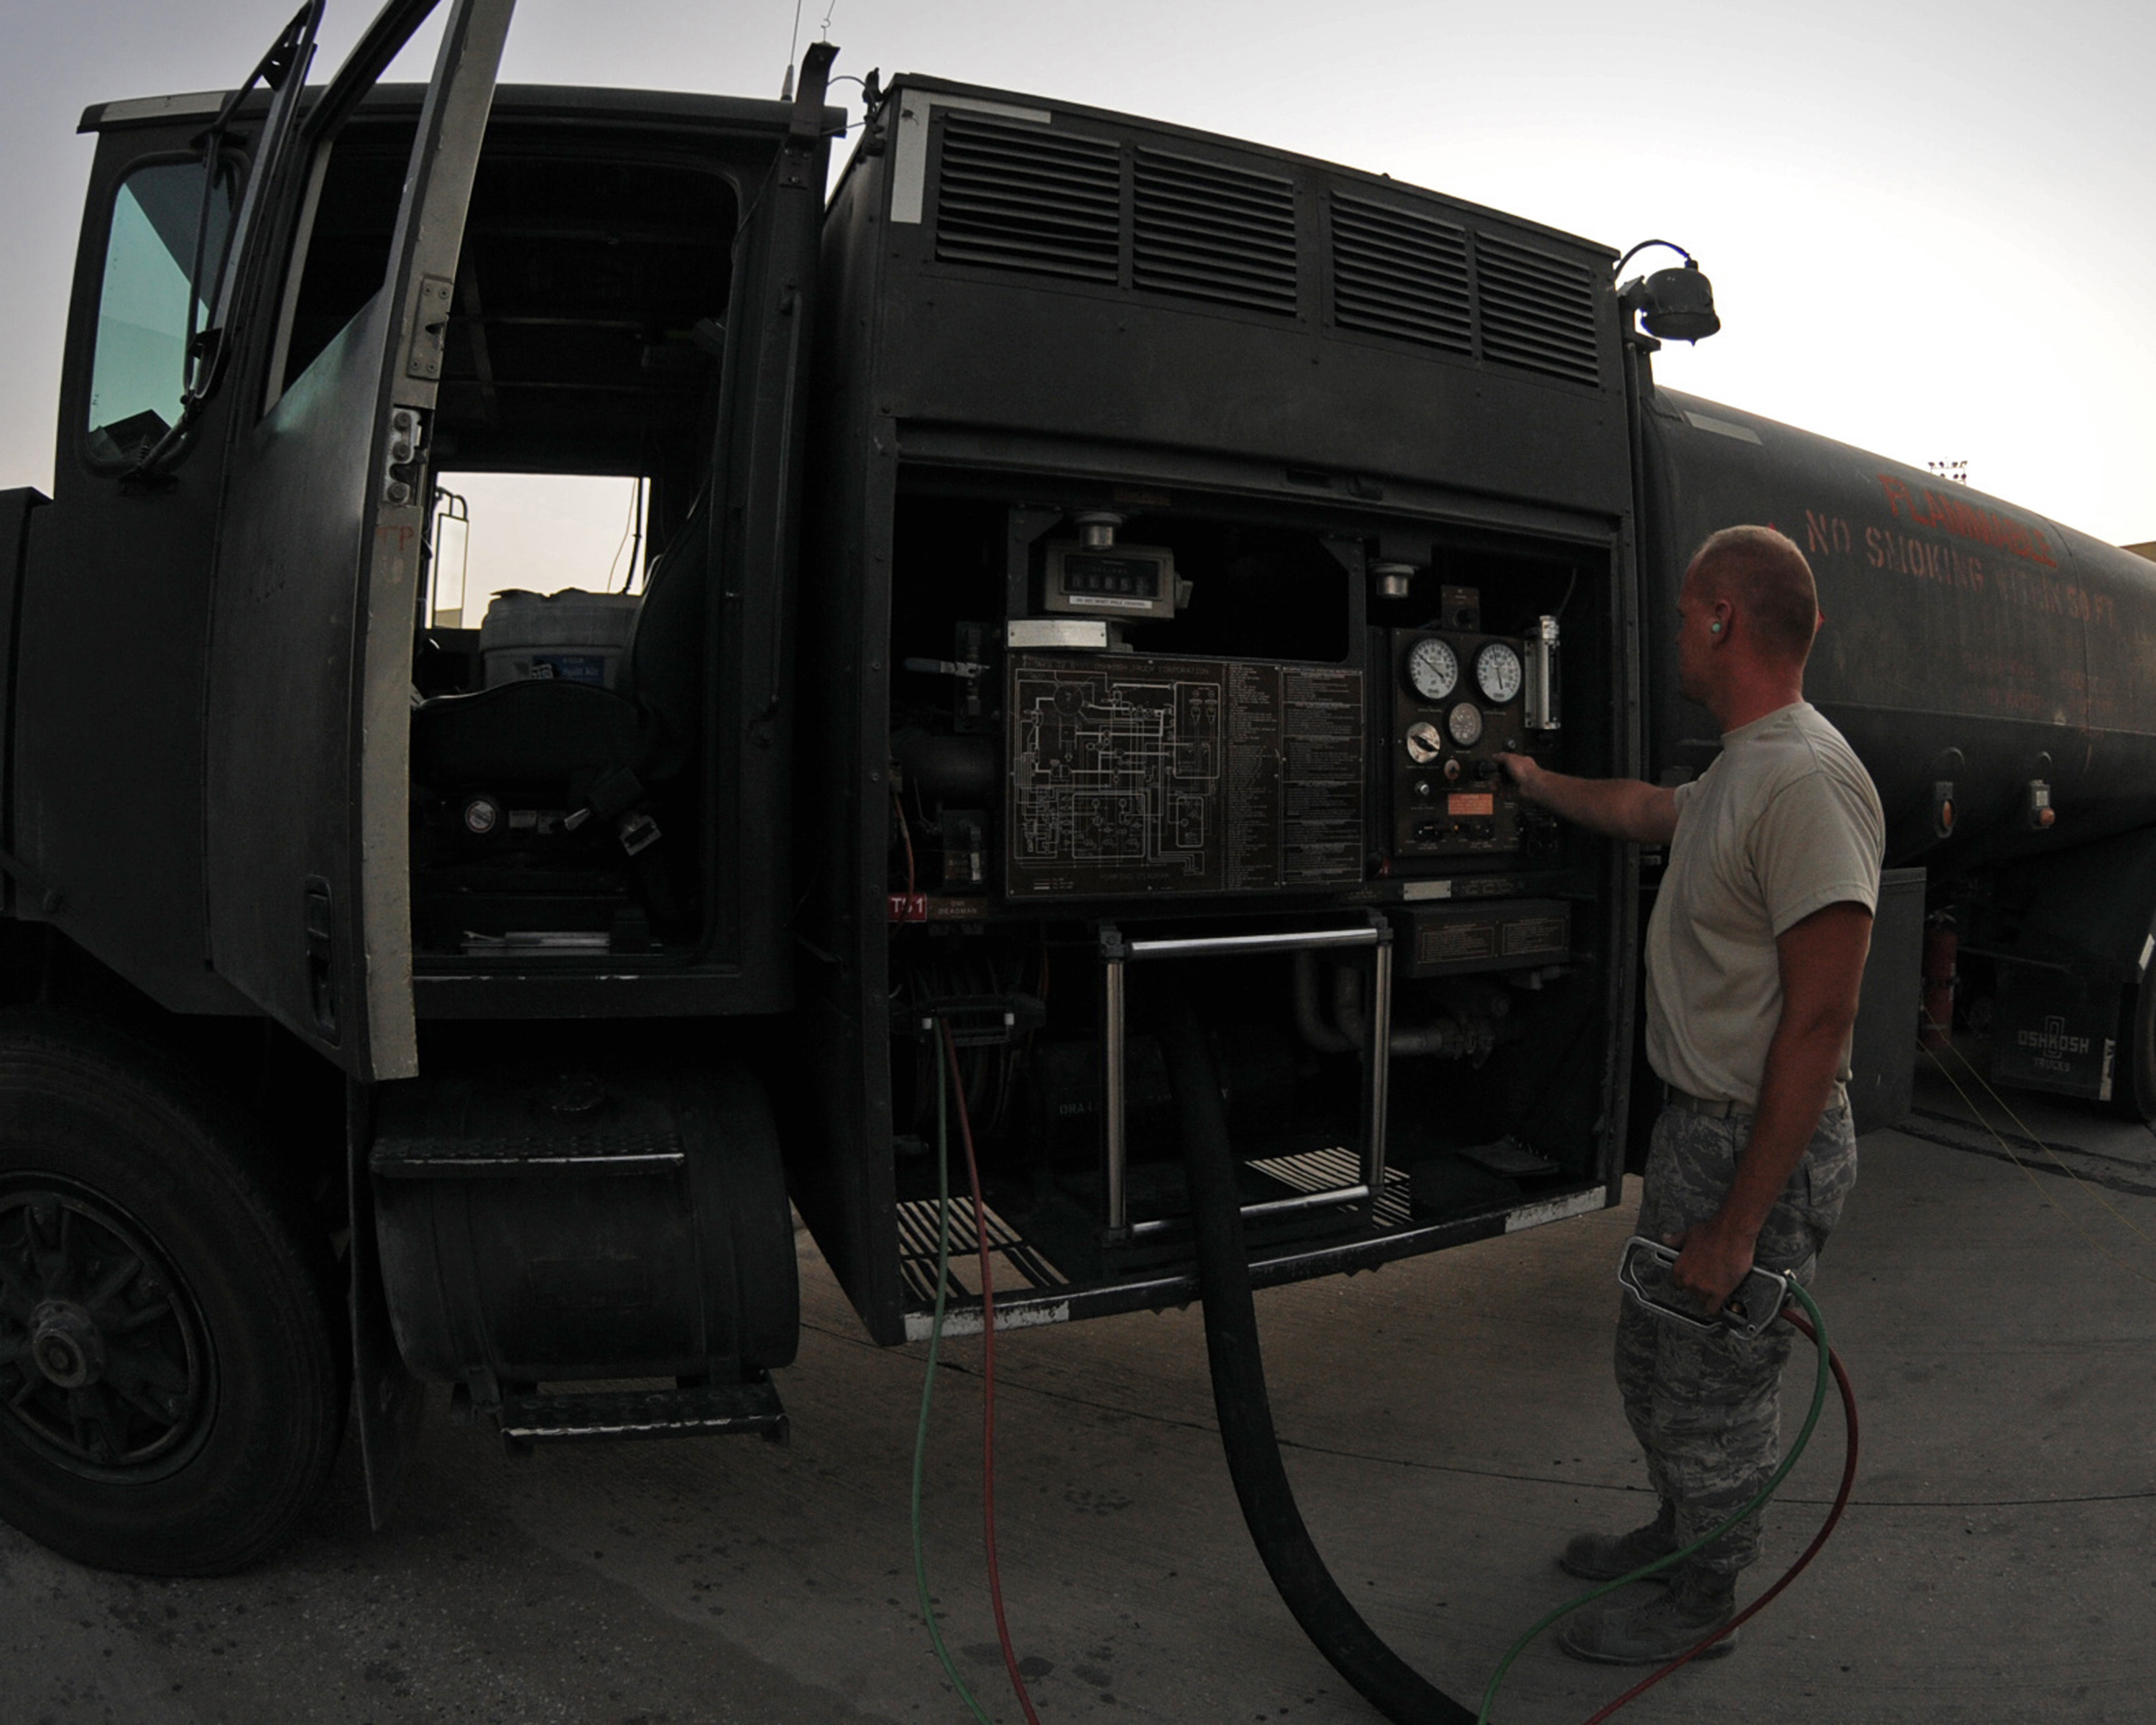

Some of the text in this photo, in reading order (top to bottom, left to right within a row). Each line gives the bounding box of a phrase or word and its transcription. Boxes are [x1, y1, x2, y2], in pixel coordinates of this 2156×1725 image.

[1805, 508, 1851, 556] NO
[1865, 525, 1985, 592] SMOKING
[2018, 1029, 2090, 1054] OSHKOSH
[2033, 1057, 2070, 1072] TRUCKS
